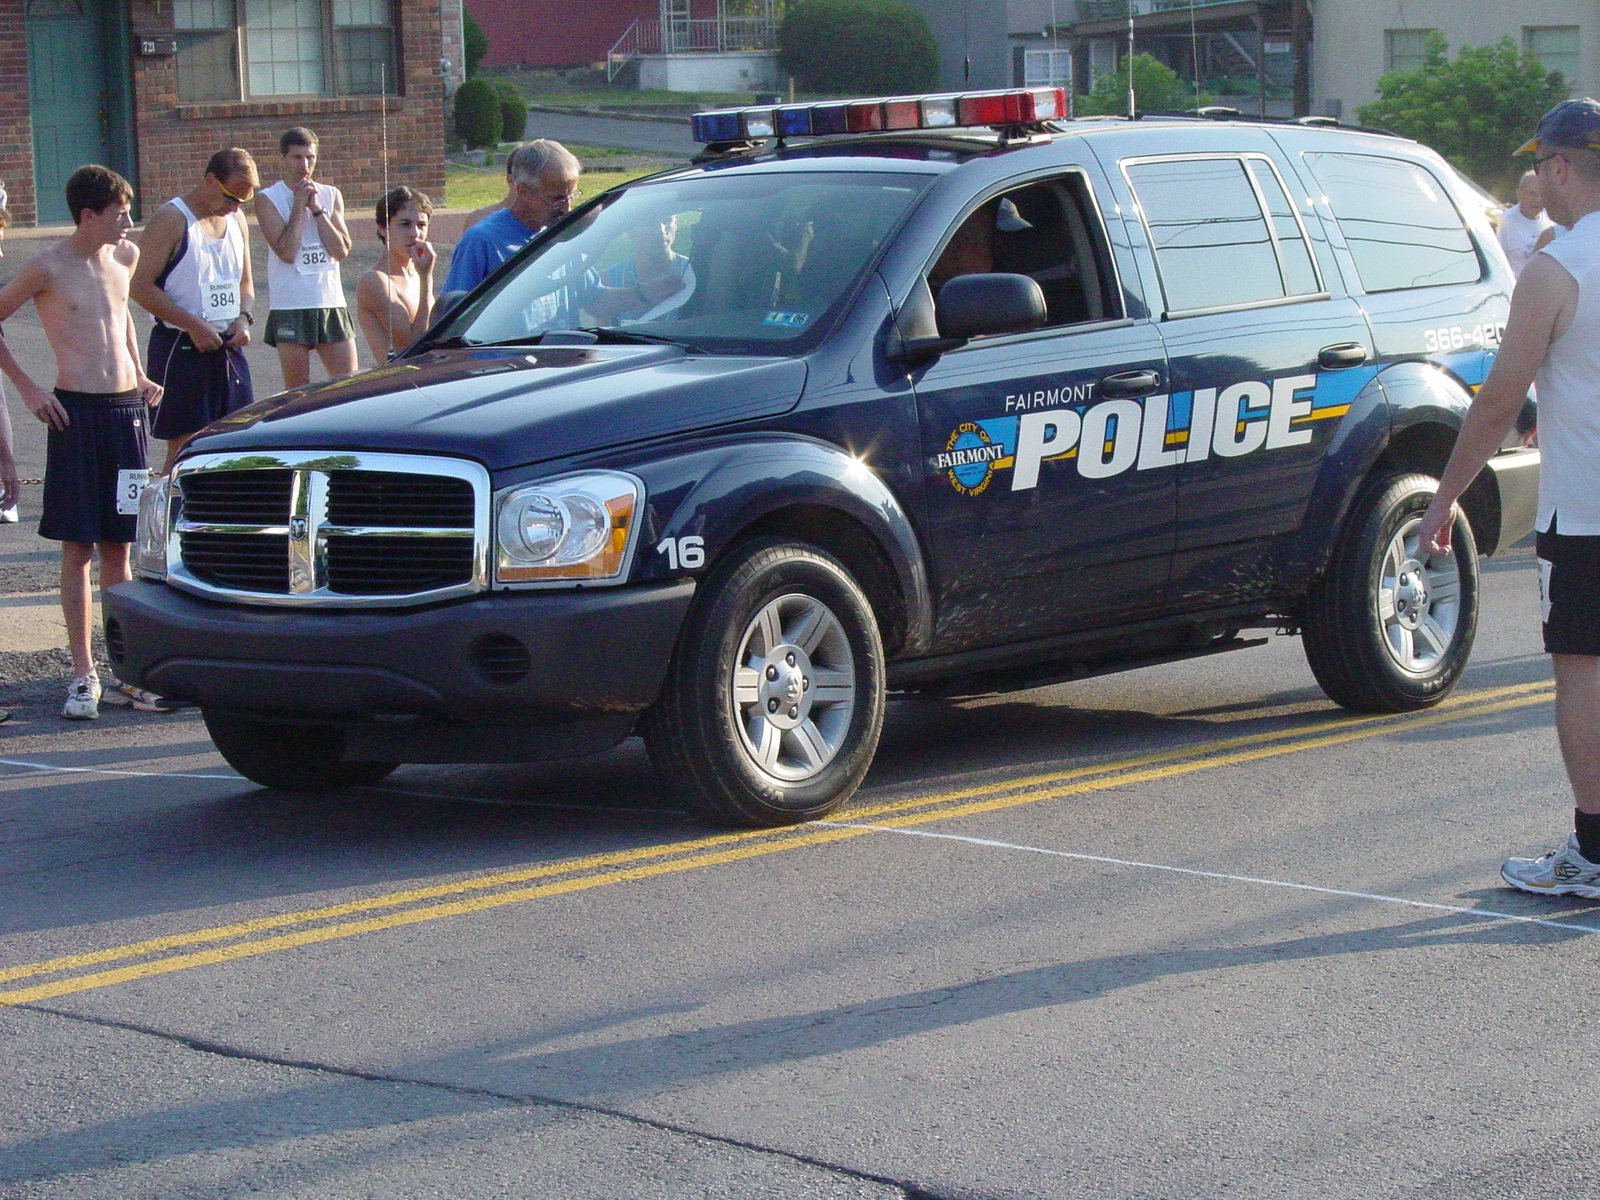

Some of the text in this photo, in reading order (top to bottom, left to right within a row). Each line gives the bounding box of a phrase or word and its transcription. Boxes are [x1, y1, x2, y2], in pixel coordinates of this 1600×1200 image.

[302, 252, 326, 265] 382
[210, 292, 235, 307] 384
[1424, 322, 1507, 352] 366-420
[1005, 383, 1095, 412] FAIRMONT
[946, 422, 991, 451] THE CITY OF
[1011, 374, 1316, 491] POLICE
[937, 445, 1003, 468] FAIRMONT
[948, 469, 966, 494] WEST
[968, 462, 994, 496] VIRGINIA
[656, 535, 705, 570] 16
